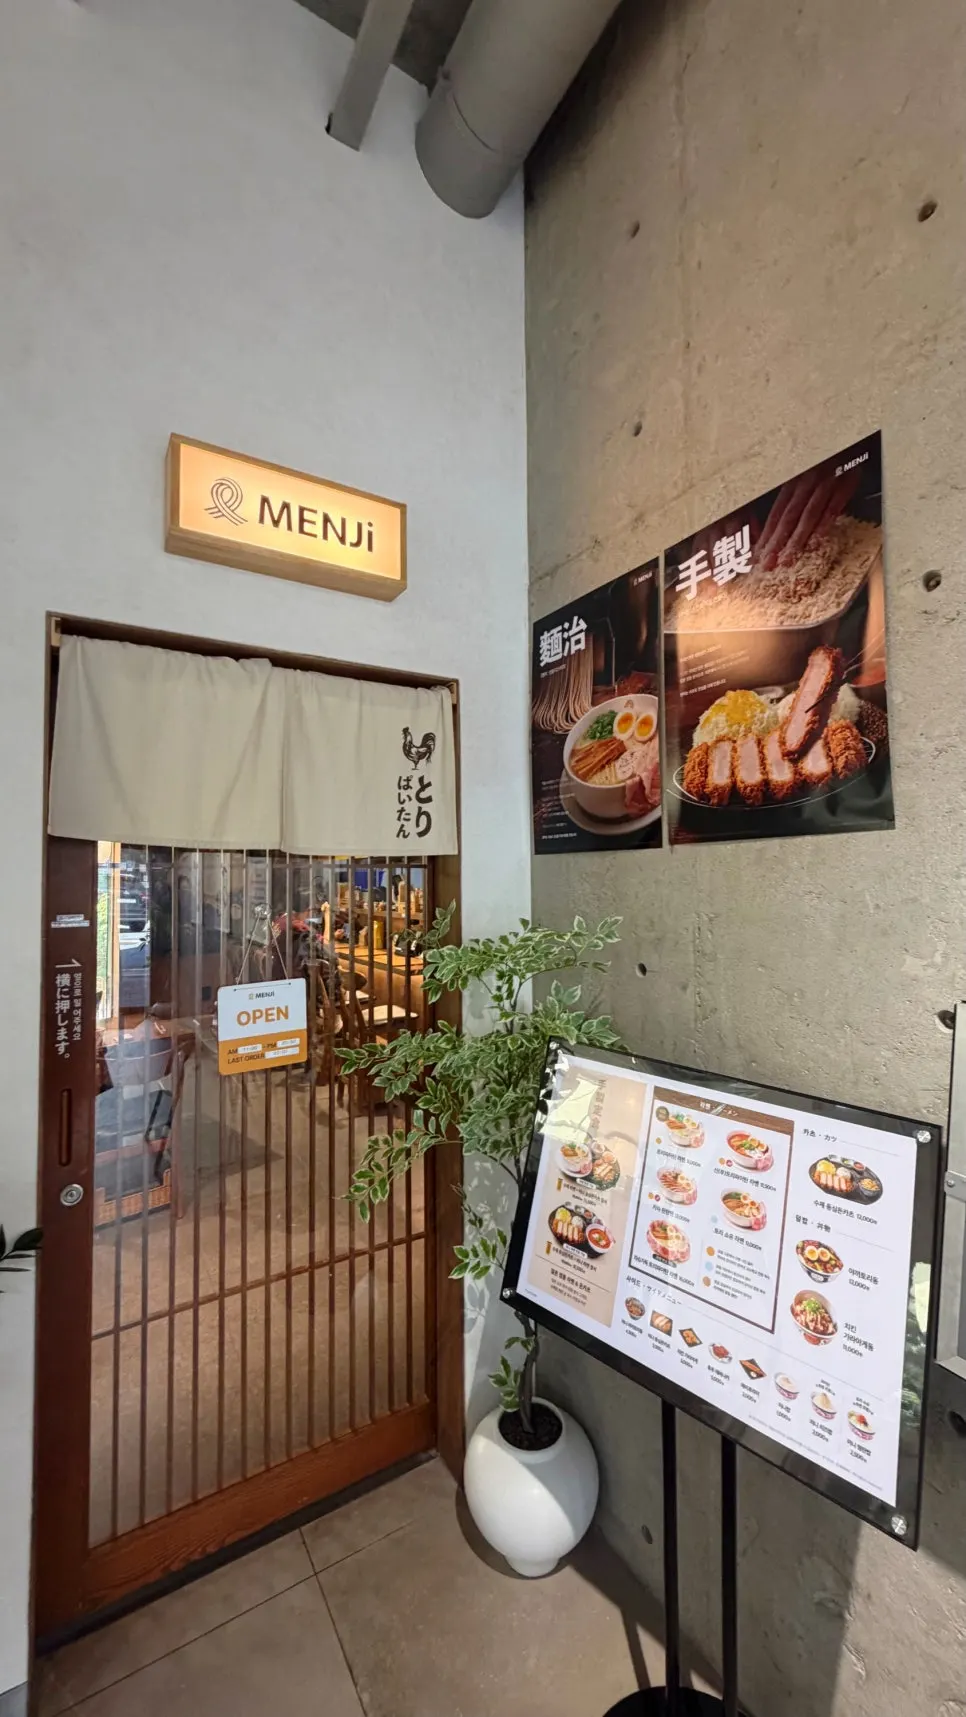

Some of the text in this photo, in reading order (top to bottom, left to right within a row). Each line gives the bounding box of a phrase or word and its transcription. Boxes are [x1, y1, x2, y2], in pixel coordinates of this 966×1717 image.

[258, 494, 374, 553] MENJi
[675, 524, 752, 601] 手製
[396, 774, 414, 839] ぱいたん
[415, 775, 433, 838] とり
[54, 973, 71, 1059] 横に押します。
[236, 1005, 289, 1027] OPEN
[227, 1053, 265, 1065] LAST ORDER
[803, 1128, 837, 1143] 카츠 カツ
[813, 1199, 825, 1209] 수제
[626, 1274, 641, 1287] 사이드
[844, 1321, 856, 1334] 치킨
[843, 1331, 874, 1352] 가라아게동
